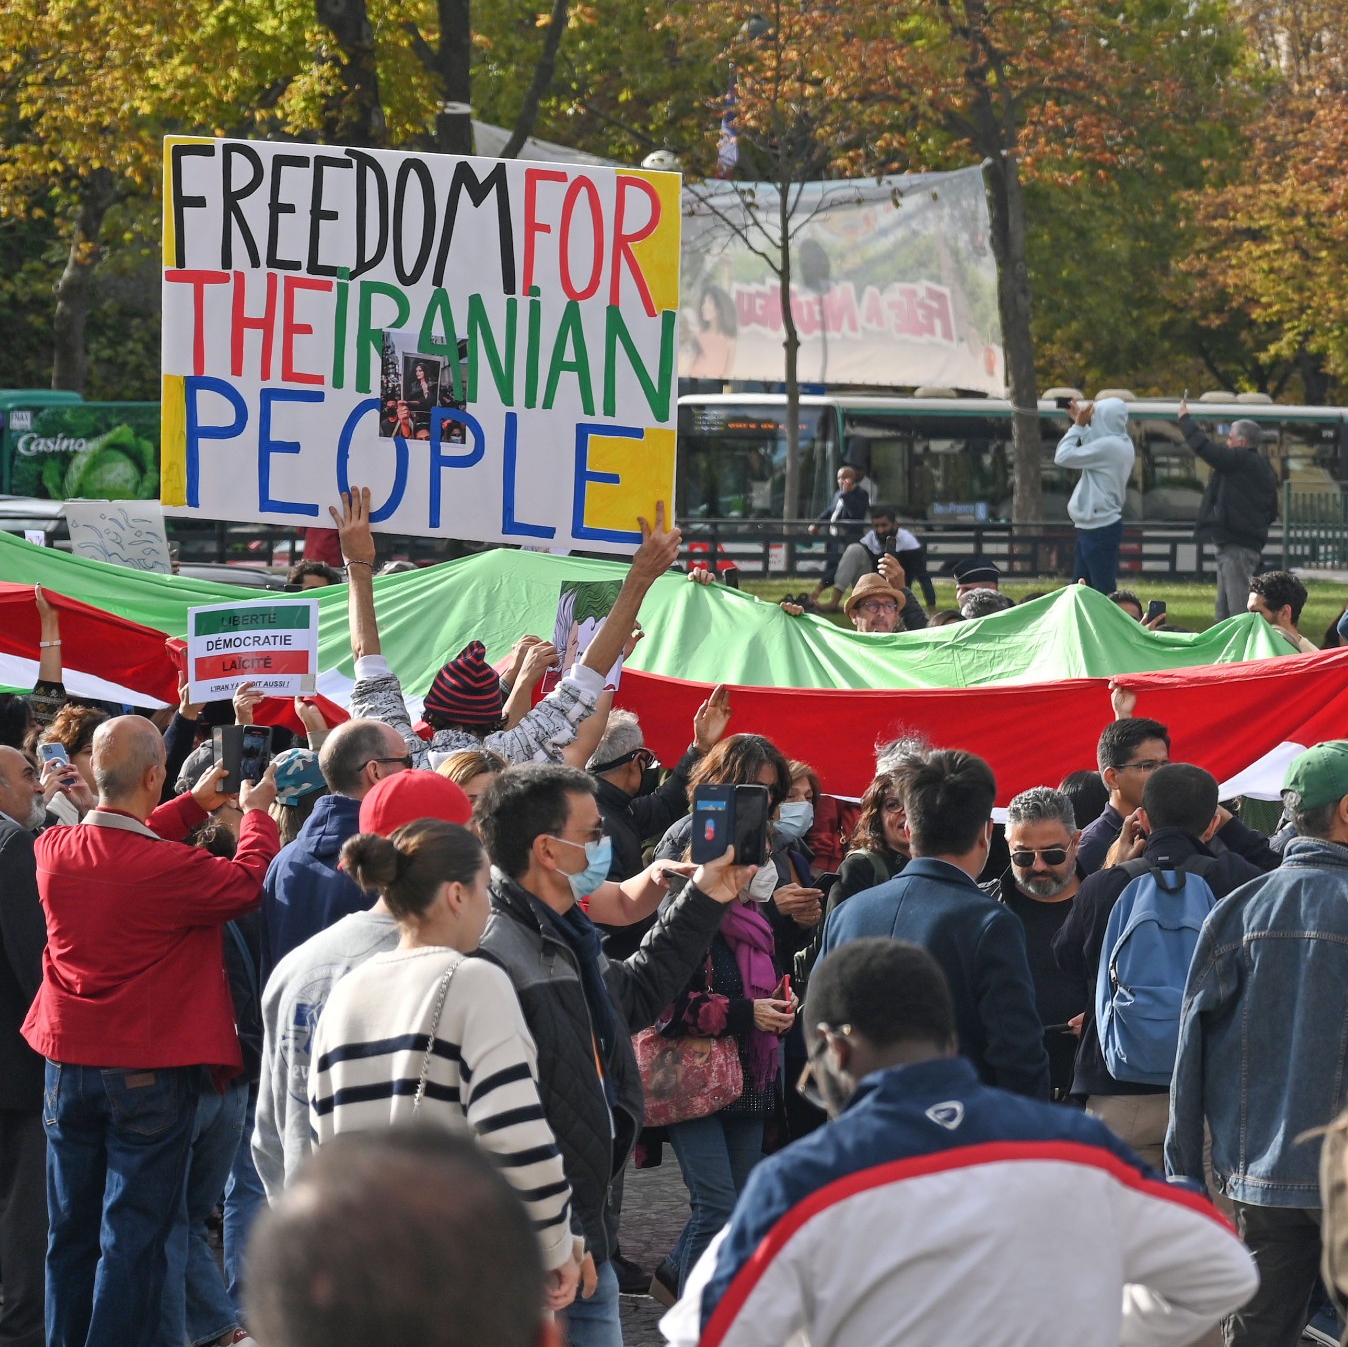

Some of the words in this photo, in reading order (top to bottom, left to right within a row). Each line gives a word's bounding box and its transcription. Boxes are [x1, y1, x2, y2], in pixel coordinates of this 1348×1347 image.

[172, 142, 518, 295] FREEDOM
[522, 167, 662, 317] FOR
[165, 269, 333, 385] THE
[331, 266, 676, 423] IRANIAN
[17, 432, 87, 457] Casino
[184, 376, 648, 544] PEOPLE
[206, 635, 292, 651] DÉMOCRATIE
[222, 655, 272, 672] LAÏCITÉ
[210, 683, 229, 692] L'IRAN
